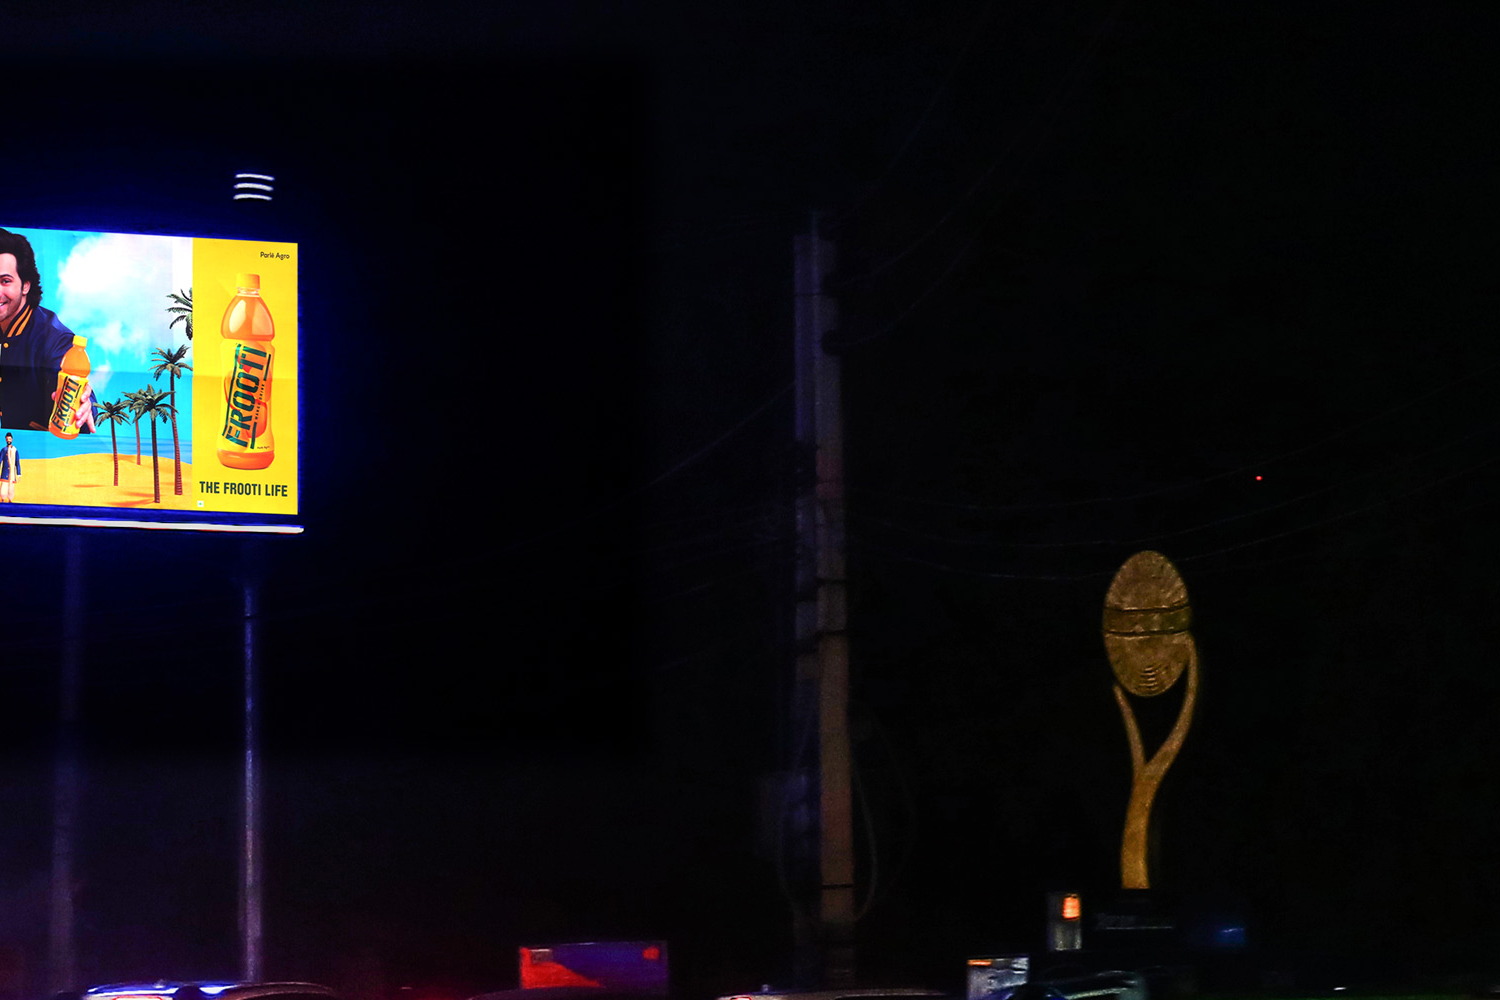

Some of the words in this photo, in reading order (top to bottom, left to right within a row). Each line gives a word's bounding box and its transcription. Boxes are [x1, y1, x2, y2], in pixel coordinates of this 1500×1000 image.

[275, 253, 290, 261] Agro
[52, 378, 79, 430] FROOTI
[225, 345, 267, 448] FROOTI
[199, 480, 220, 494] THE
[223, 482, 261, 496] FROOTI
[265, 484, 288, 497] LIFE
